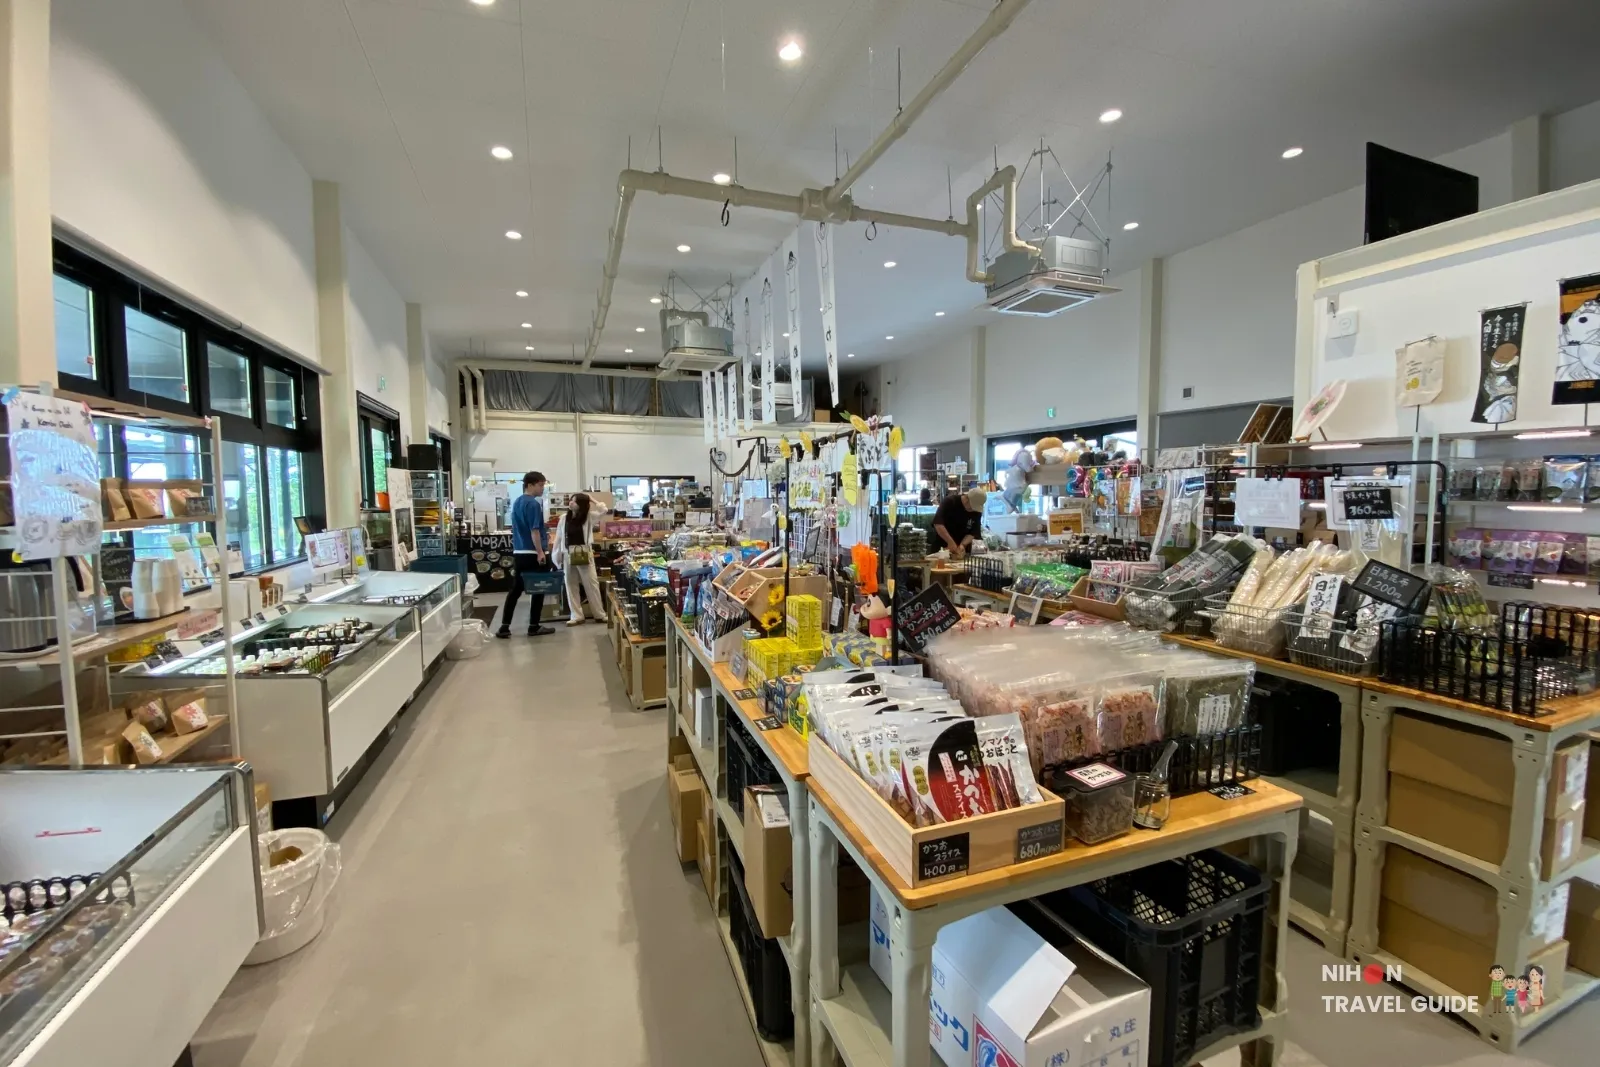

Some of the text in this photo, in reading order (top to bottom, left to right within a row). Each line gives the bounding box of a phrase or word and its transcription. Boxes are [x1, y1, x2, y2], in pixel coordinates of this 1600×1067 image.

[952, 784, 969, 819] スライス
[922, 840, 948, 854] かつお
[934, 848, 962, 862] スライス
[924, 864, 956, 877] 400円
